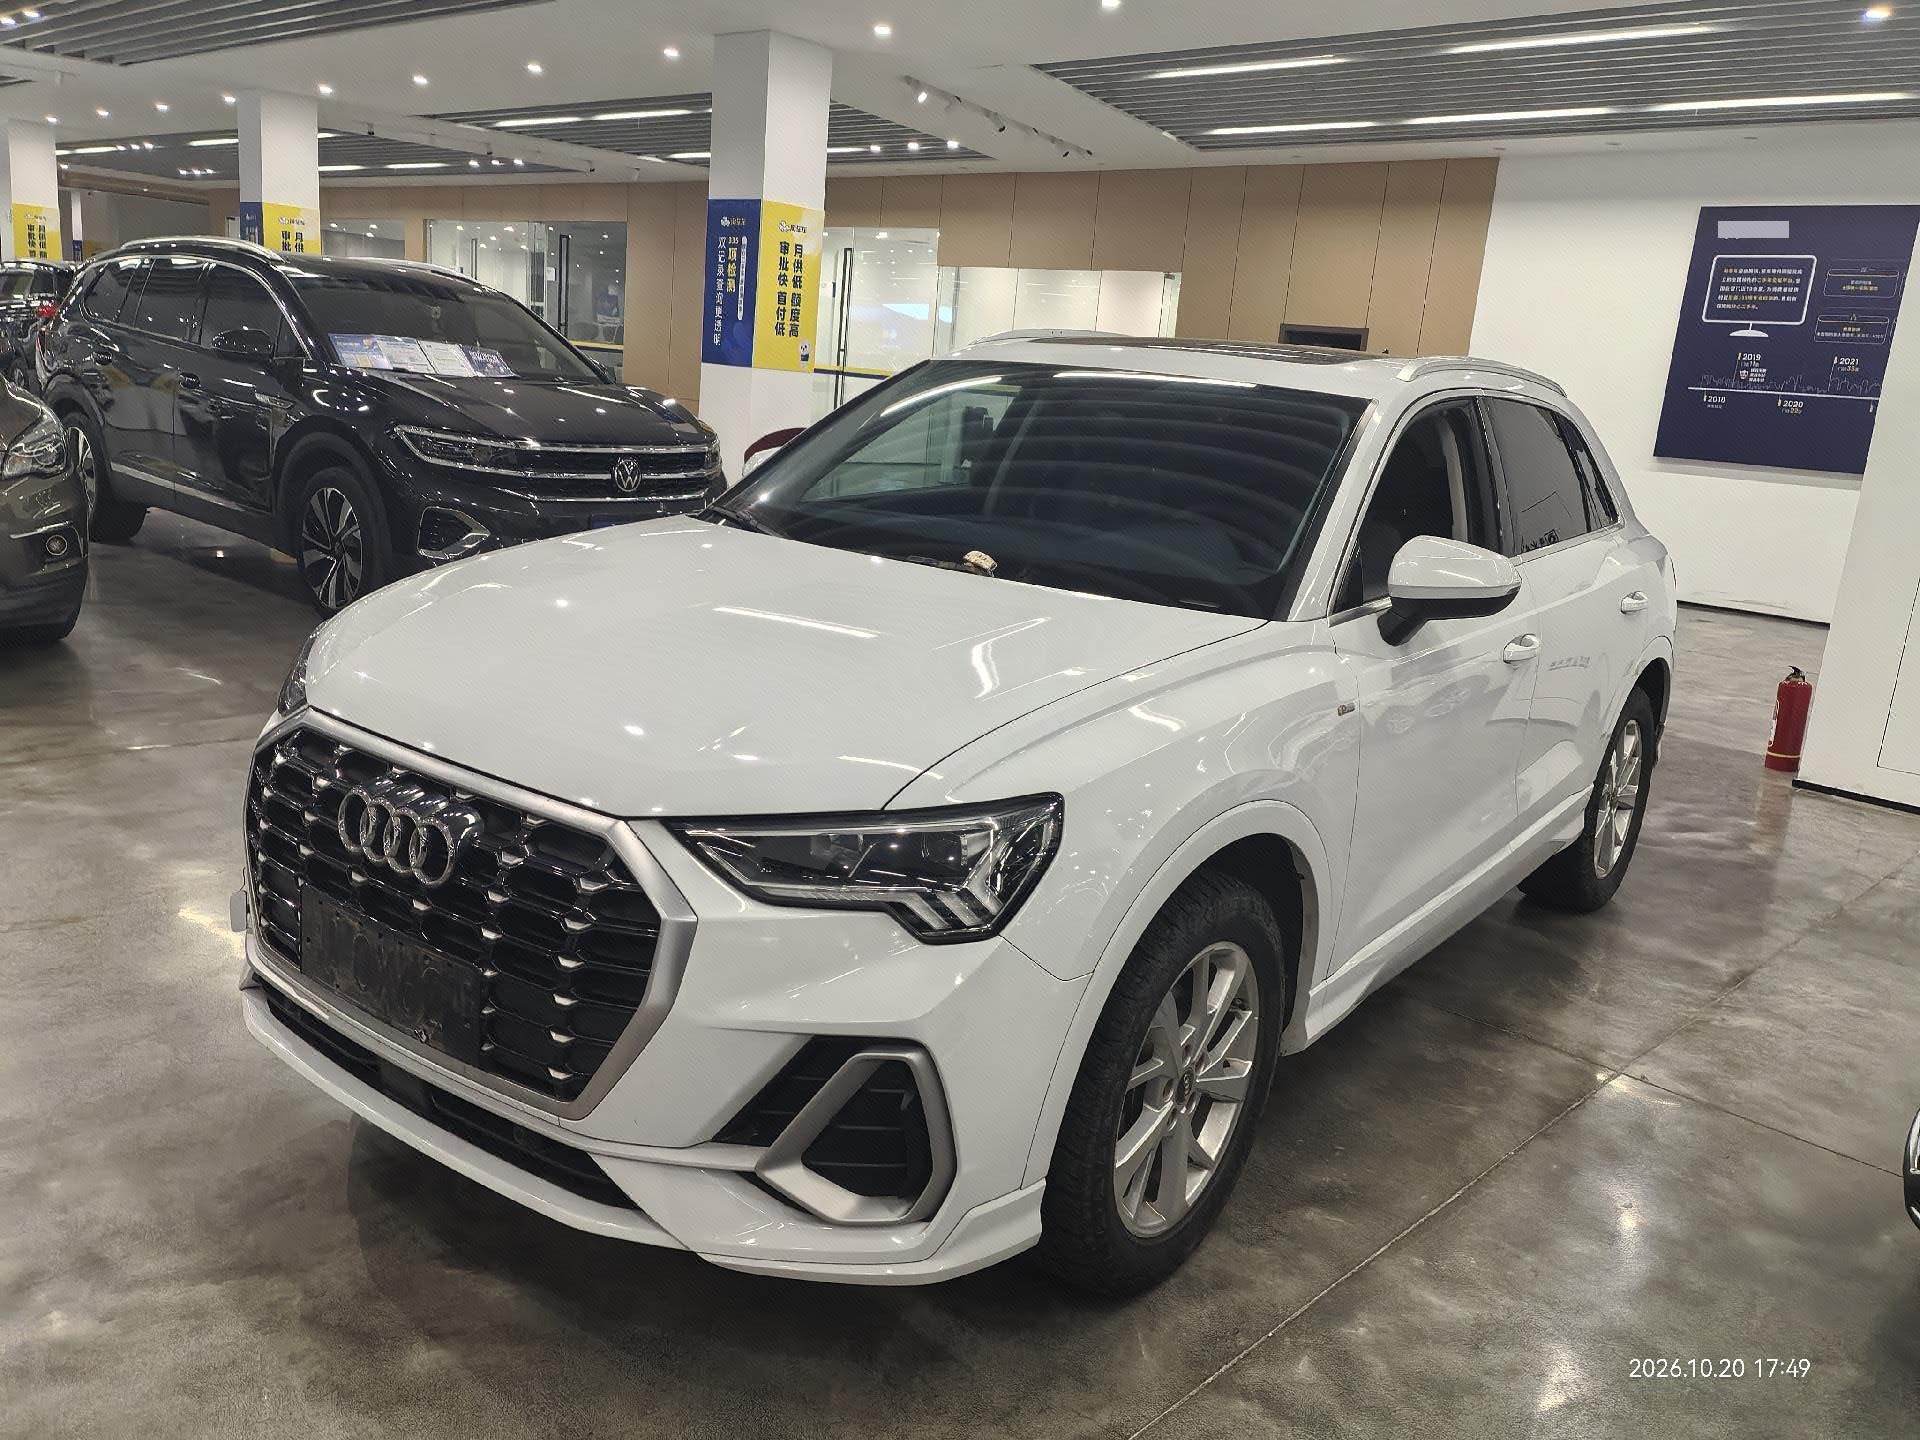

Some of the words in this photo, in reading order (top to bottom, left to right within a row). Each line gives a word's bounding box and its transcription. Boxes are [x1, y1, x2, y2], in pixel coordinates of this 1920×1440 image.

[1742, 353, 1761, 361] 2019
[1839, 357, 1859, 365] 2021
[1782, 400, 1804, 408] 2020
